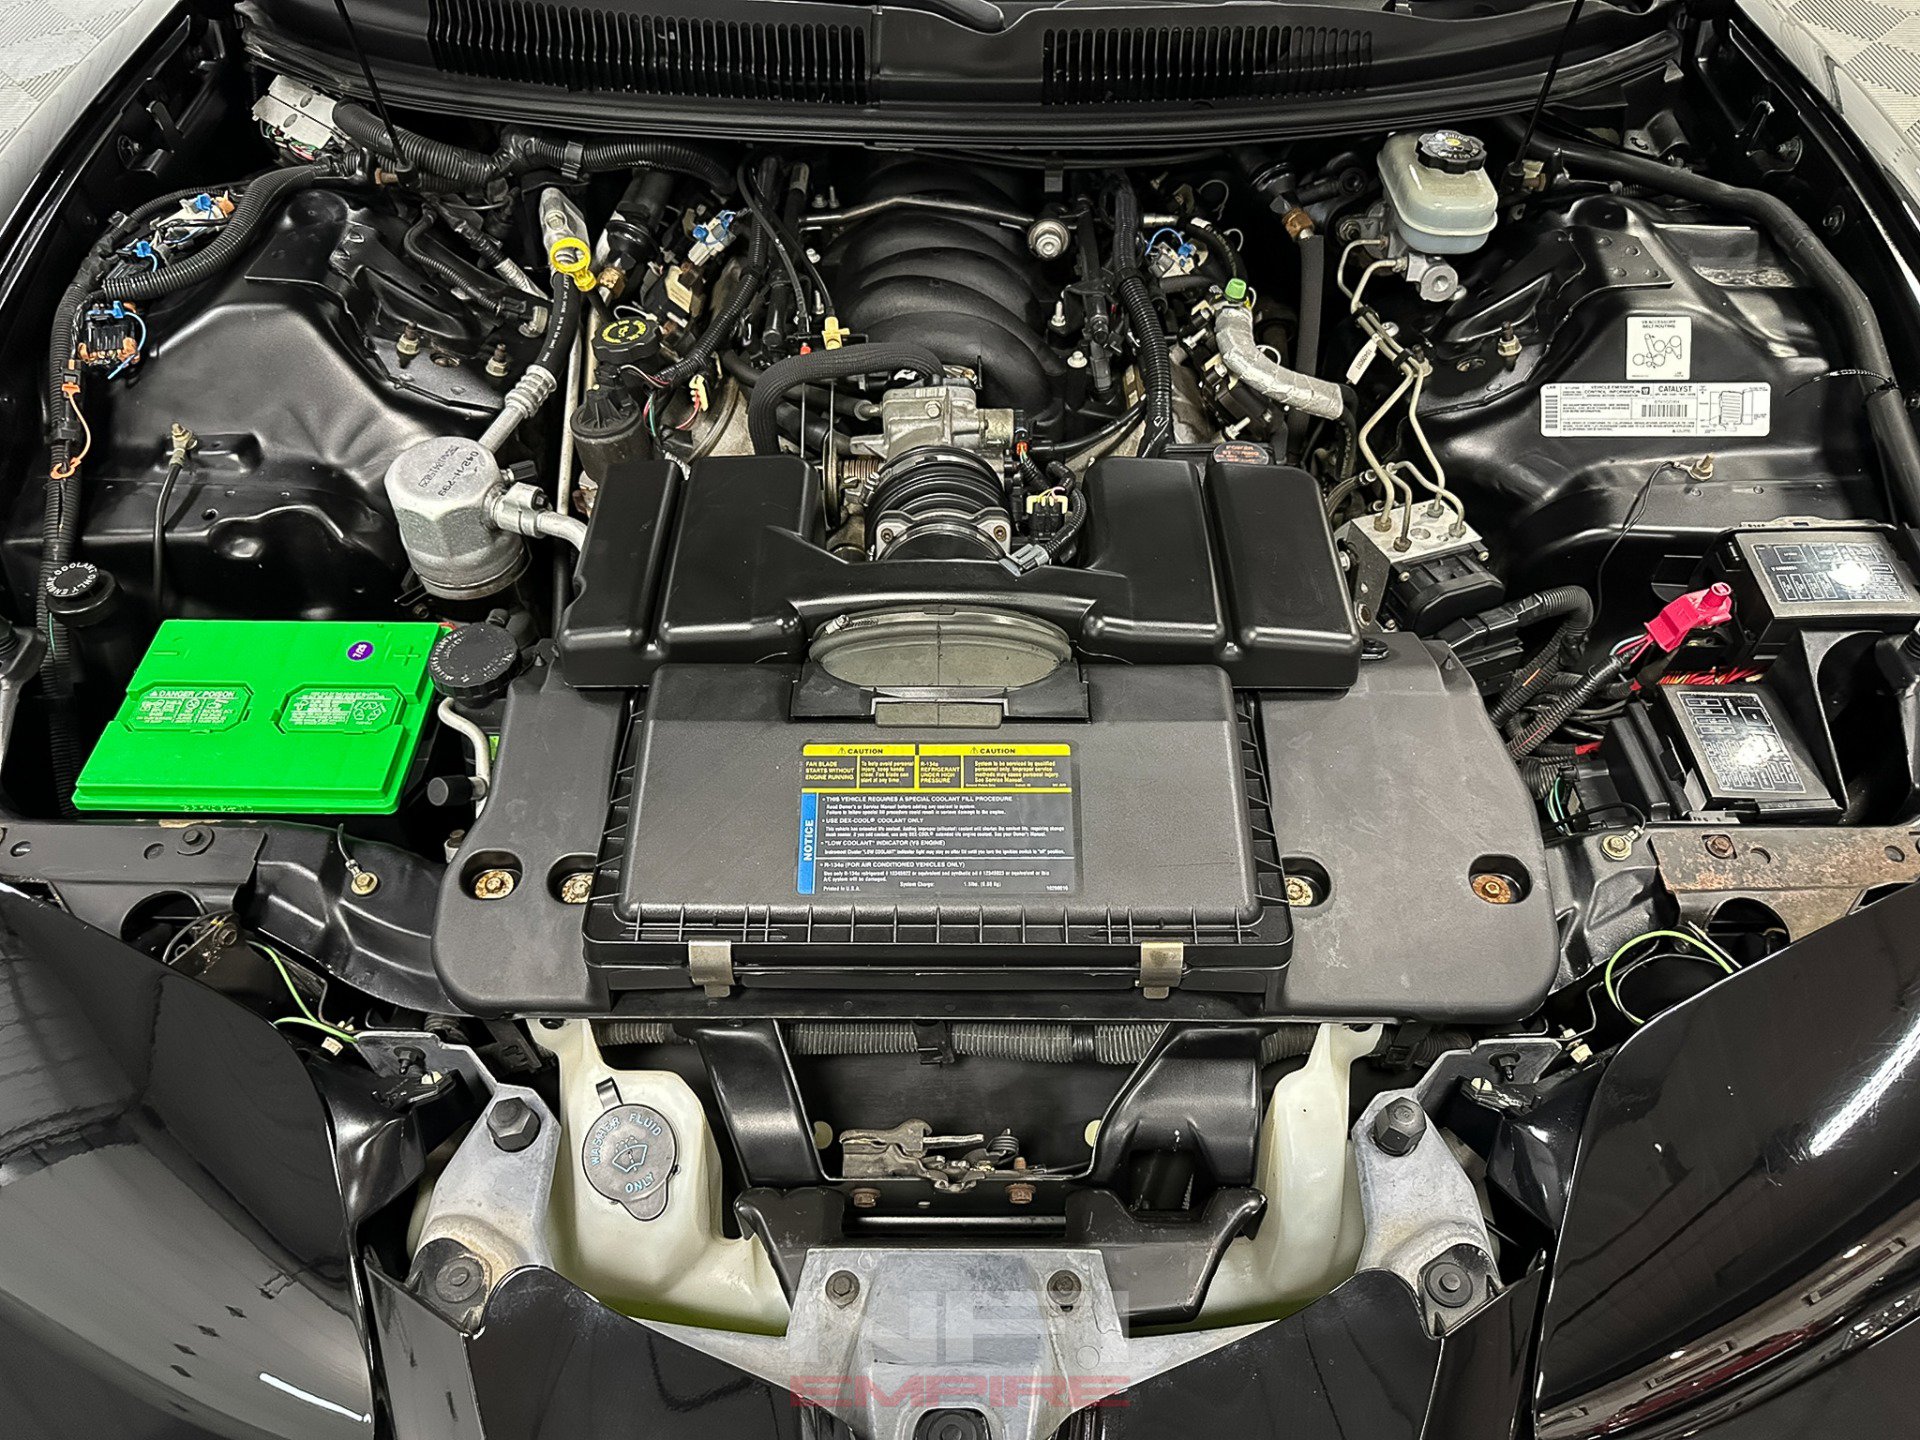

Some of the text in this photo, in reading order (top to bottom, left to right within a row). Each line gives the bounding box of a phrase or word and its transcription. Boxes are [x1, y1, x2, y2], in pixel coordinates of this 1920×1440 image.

[803, 819, 814, 861] NOTICE
[591, 1112, 663, 1166] WASHER FLUID
[625, 1171, 655, 1194] ONLY
